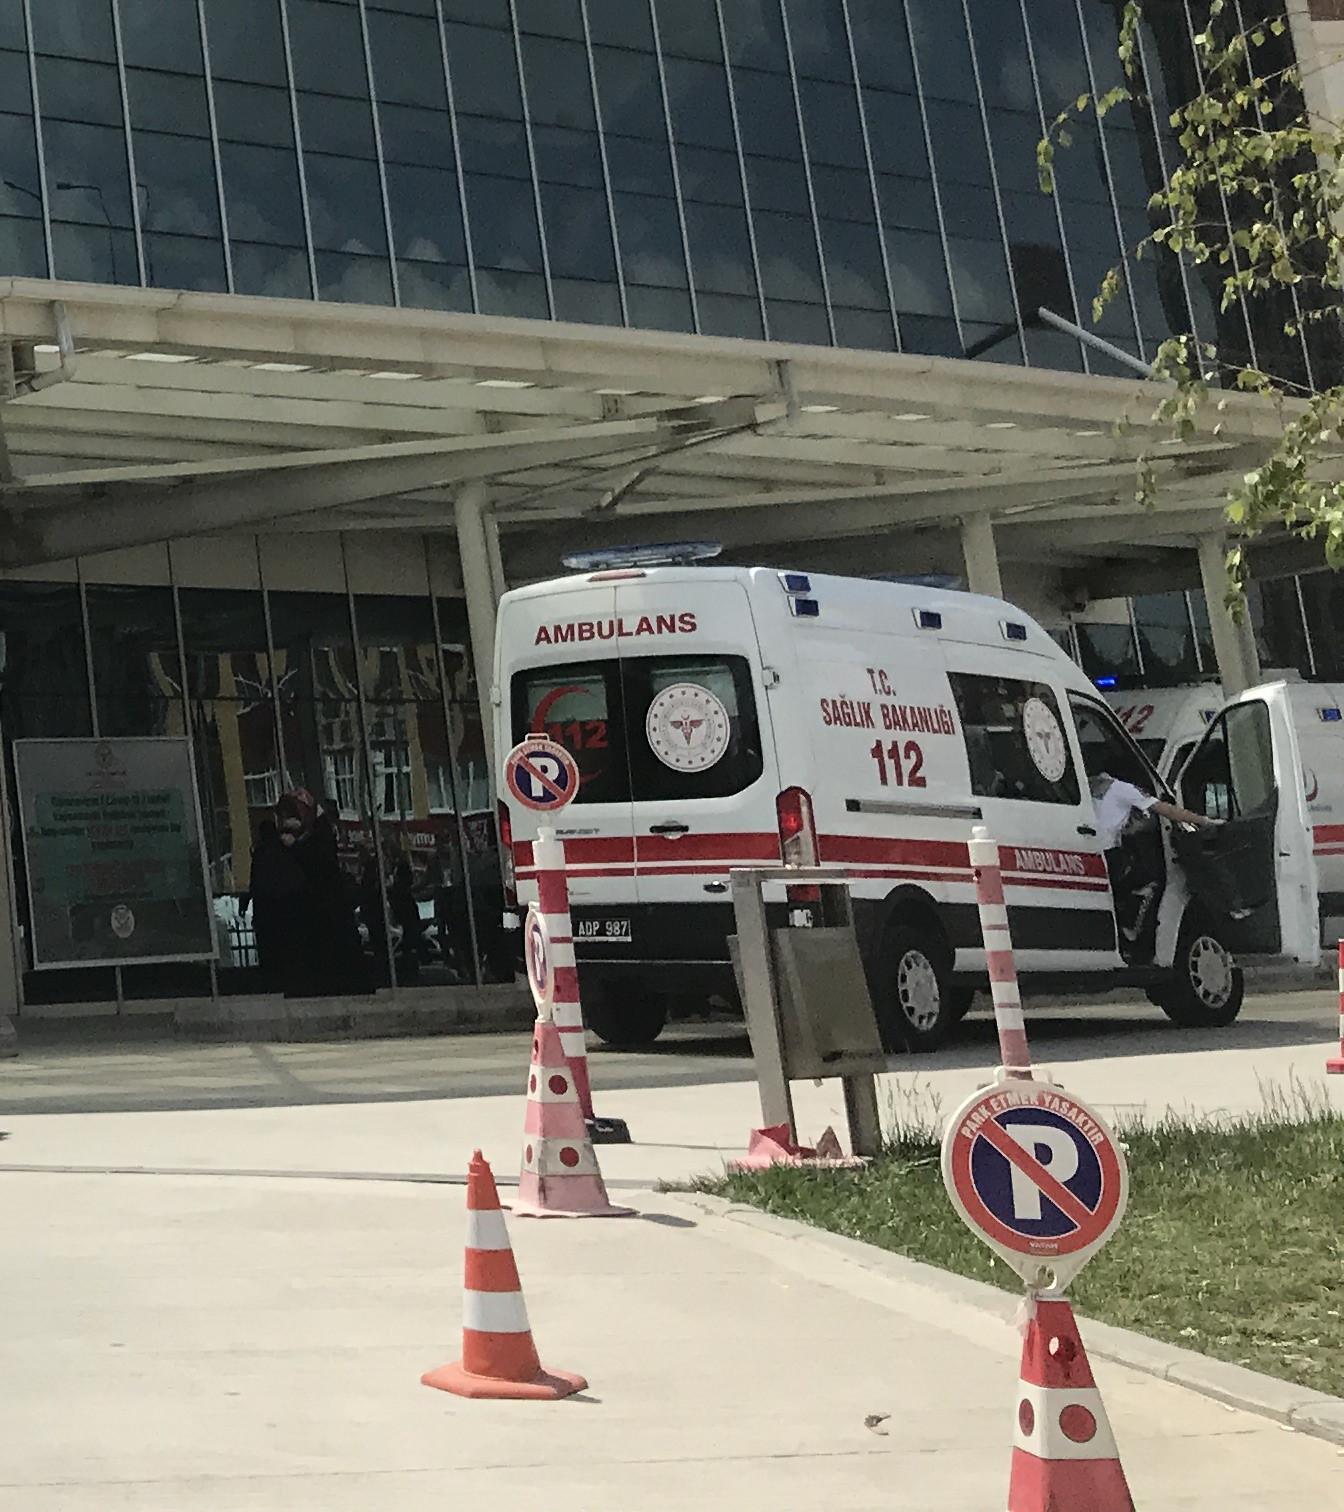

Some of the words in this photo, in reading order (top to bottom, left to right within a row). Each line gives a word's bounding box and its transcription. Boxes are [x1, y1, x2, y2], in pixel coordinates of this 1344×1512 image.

[533, 611, 698, 646] AMBULANS
[866, 667, 897, 697] T.C.
[819, 694, 875, 730] SAĞLIK
[881, 703, 956, 736] BAKANLIĞI
[869, 738, 927, 789] 112
[1014, 849, 1087, 876] AMBULANS
[578, 920, 600, 937] ADP
[605, 919, 628, 936] 987
[961, 1104, 991, 1140] PARK
[989, 1091, 1039, 1111] ETMEK
[1043, 1093, 1105, 1145] YASAKTIR
